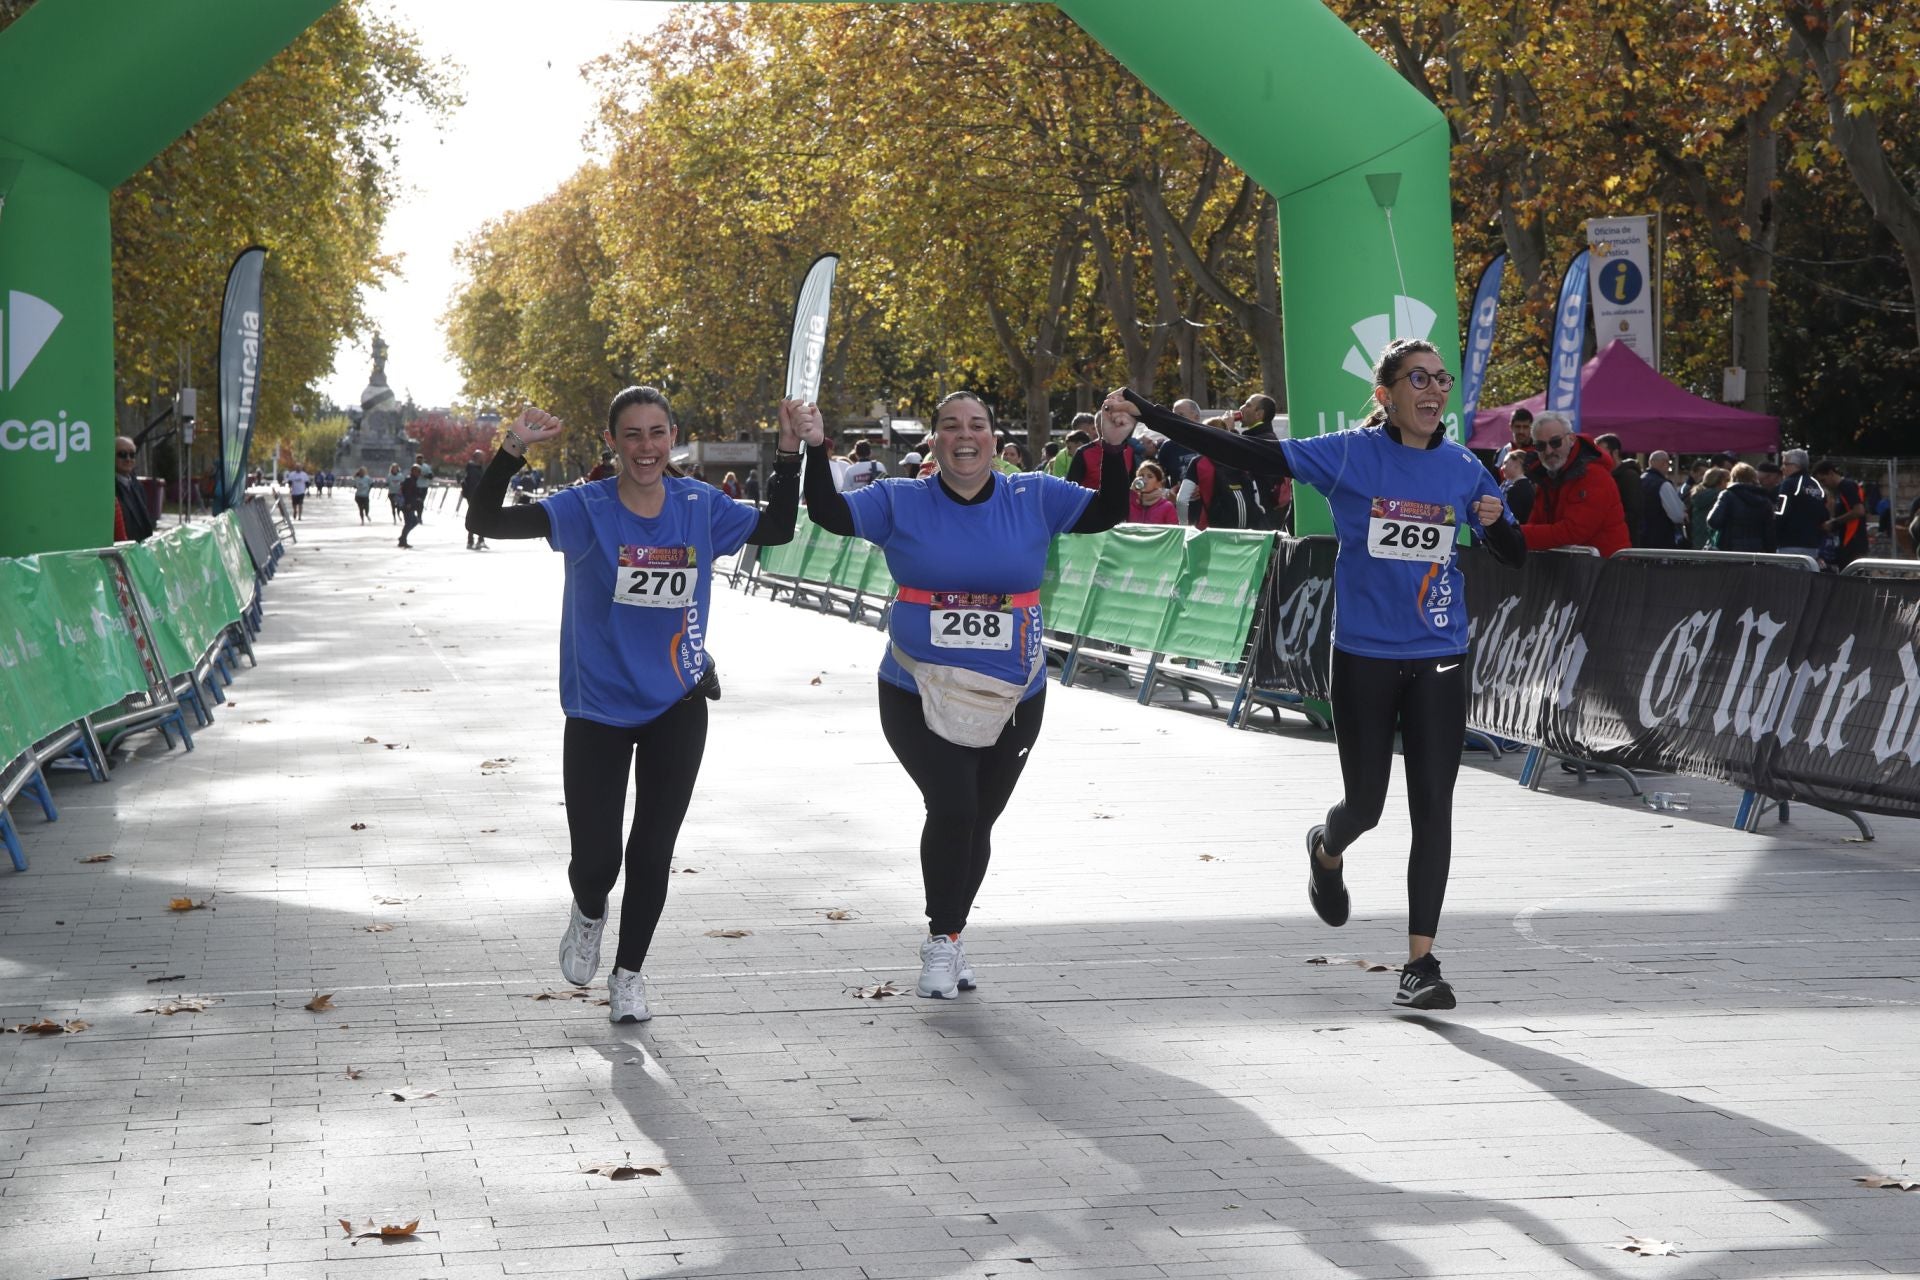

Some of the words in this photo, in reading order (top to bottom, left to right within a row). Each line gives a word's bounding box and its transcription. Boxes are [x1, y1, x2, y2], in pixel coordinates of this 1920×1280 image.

[1621, 226, 1631, 234] de
[1379, 522, 1440, 550] 269
[628, 571, 687, 596] 270
[942, 612, 1001, 638] 268
[682, 643, 693, 669] grupo
[1713, 606, 1872, 758] Norte
